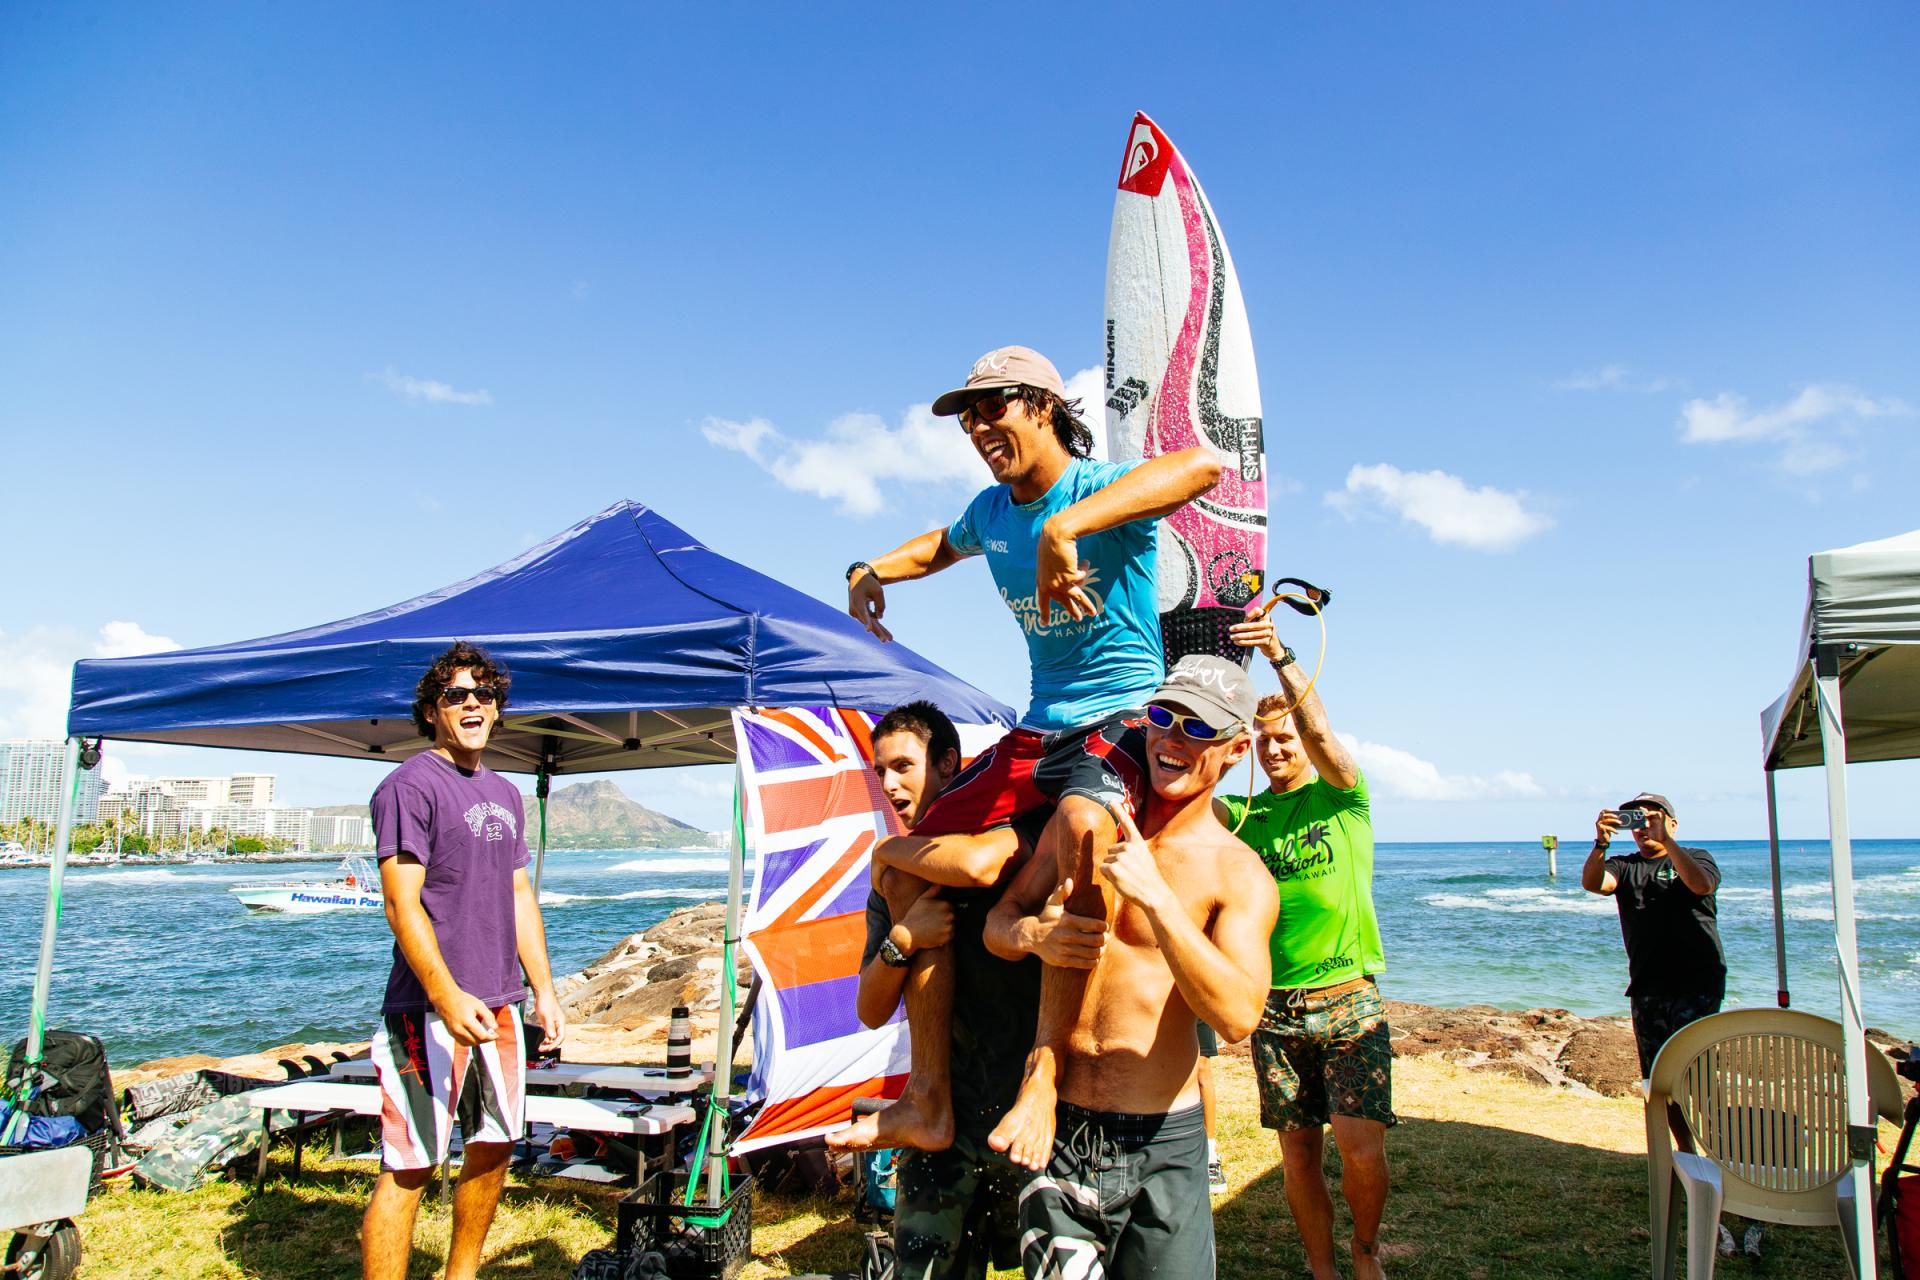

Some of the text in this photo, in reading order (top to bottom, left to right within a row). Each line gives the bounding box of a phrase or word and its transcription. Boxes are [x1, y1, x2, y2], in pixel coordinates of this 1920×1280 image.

[1107, 319, 1115, 389] MINAMI
[1241, 419, 1260, 481] SMITH
[991, 540, 1009, 553] WSL
[1054, 617, 1110, 638] HAWAII
[1295, 866, 1336, 880] HAWAII
[291, 893, 356, 906] Hawaiian
